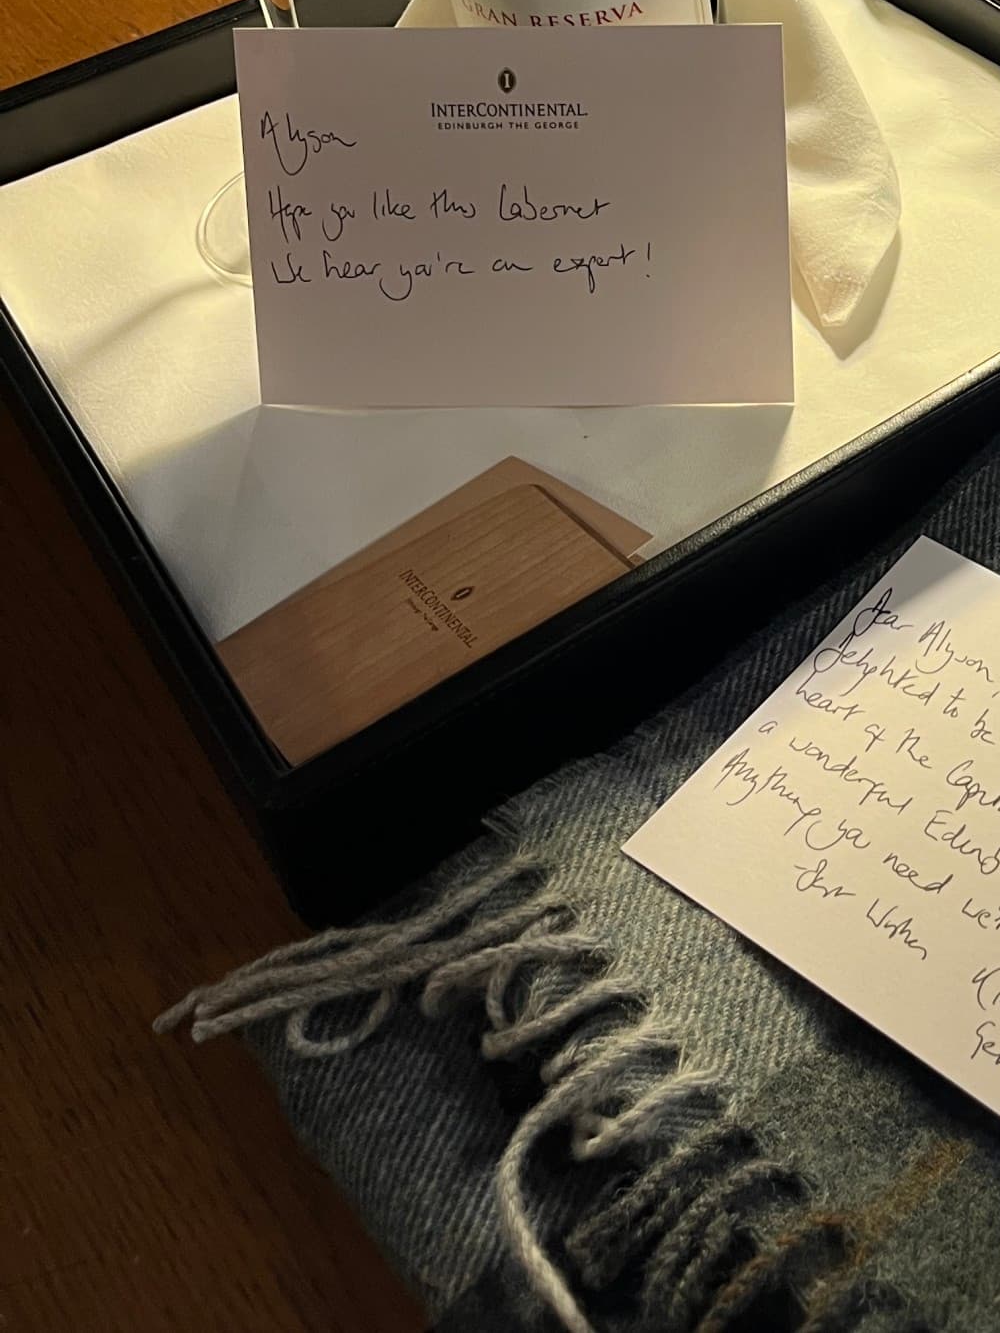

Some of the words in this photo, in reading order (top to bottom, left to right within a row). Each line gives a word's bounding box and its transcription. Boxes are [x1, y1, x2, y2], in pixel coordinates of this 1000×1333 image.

[261, 111, 357, 176] Alyson
[438, 122, 503, 130] EDINBURGH
[509, 121, 529, 129] THE
[534, 121, 579, 129] GEORGE
[372, 189, 416, 221] like
[430, 189, 476, 219] this
[500, 184, 612, 221] Cabernet
[270, 252, 312, 284] We
[322, 250, 381, 279] hear
[492, 258, 533, 272] an
[850, 588, 914, 637] Dear
[795, 671, 866, 721] heart
[864, 722, 886, 752] of
[896, 727, 933, 769] the
[943, 687, 966, 719] to
[970, 708, 996, 745] be
[789, 737, 914, 815] wonderful
[714, 748, 822, 836] Anything
[883, 852, 954, 895] need
